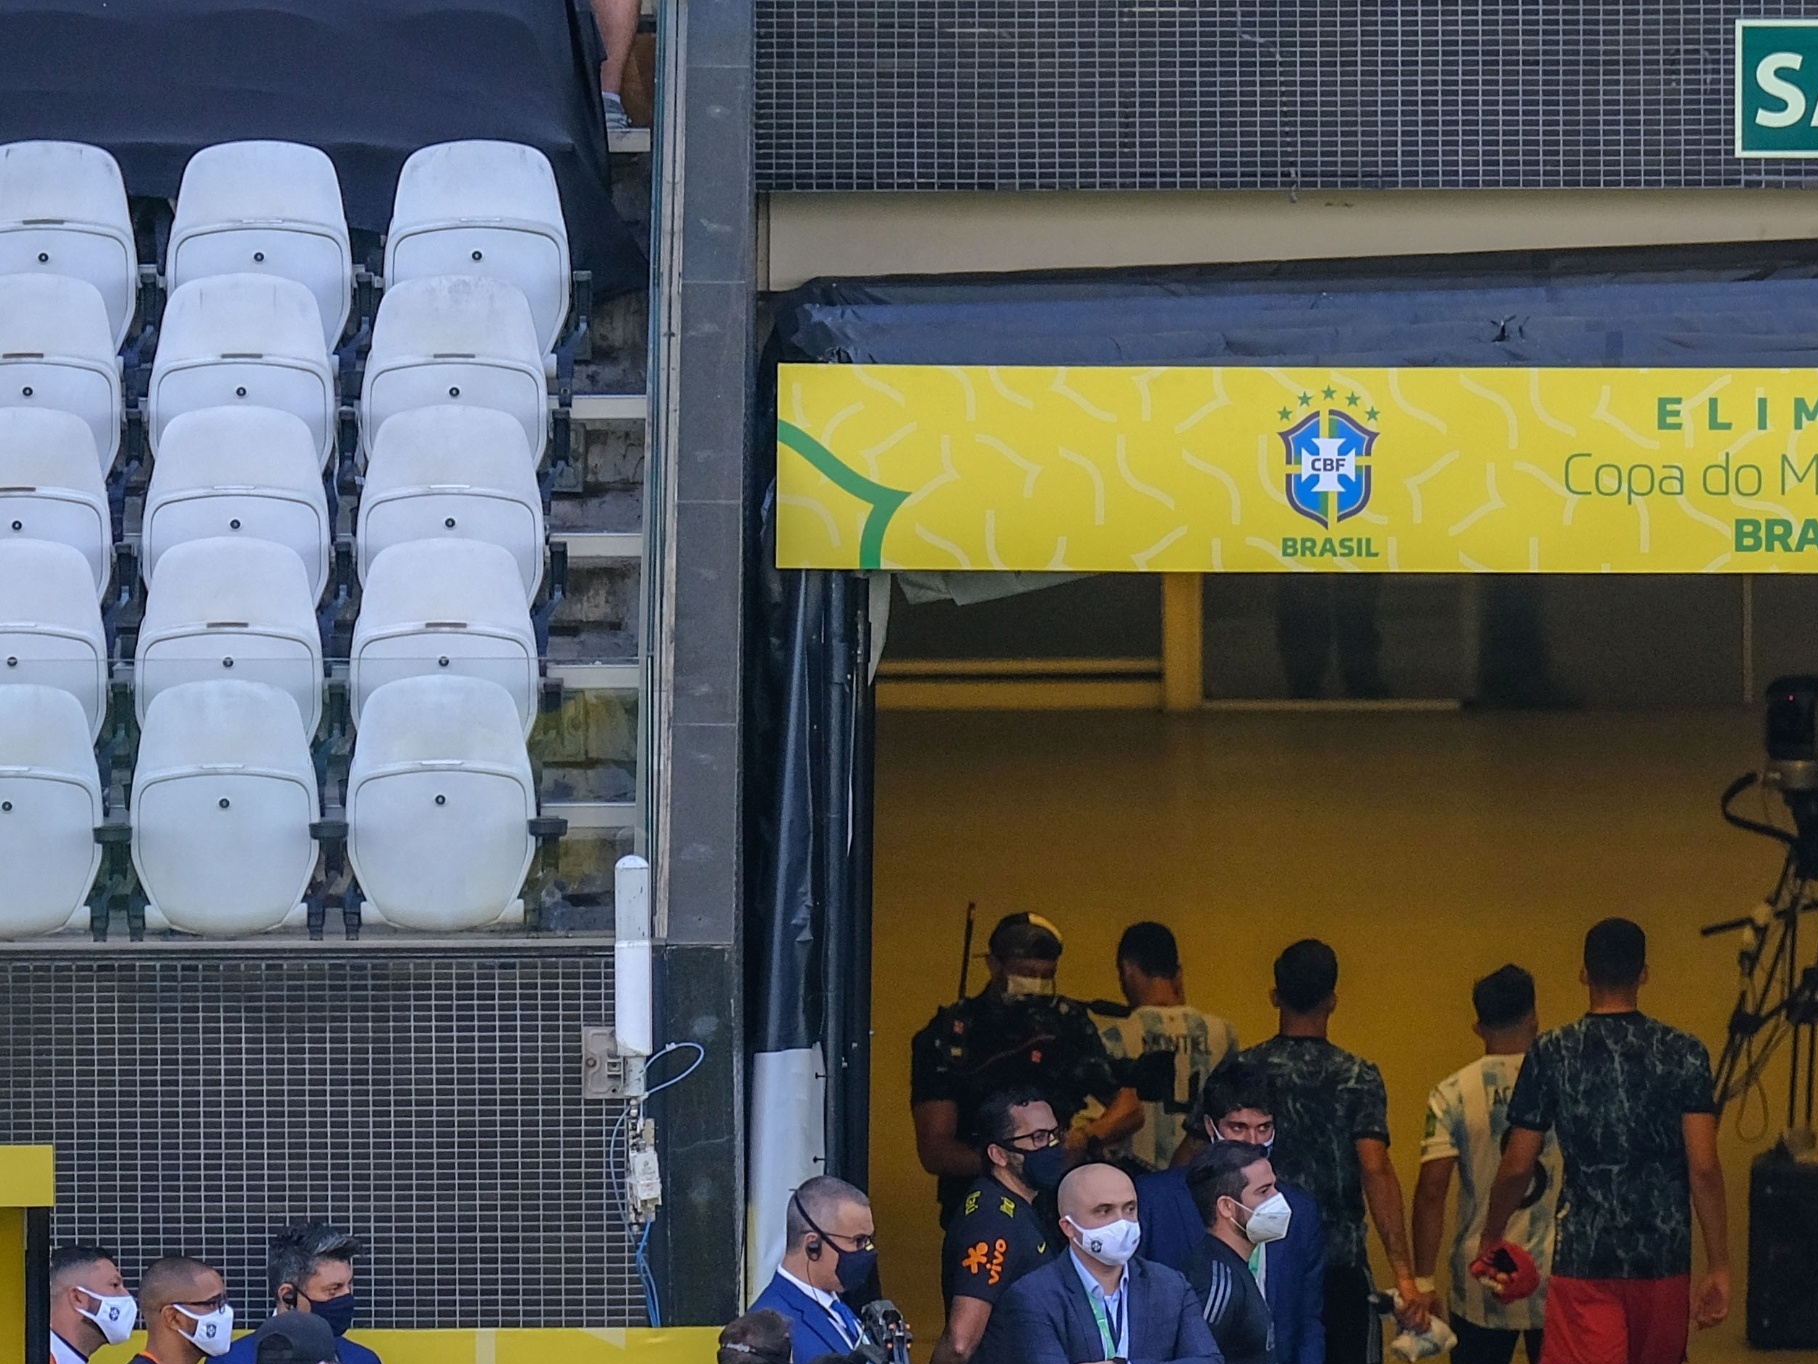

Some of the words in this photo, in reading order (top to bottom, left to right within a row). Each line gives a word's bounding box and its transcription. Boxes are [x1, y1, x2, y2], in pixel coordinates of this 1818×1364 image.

[1311, 457, 1346, 472] CBF
[1564, 453, 1684, 505] Copa
[1702, 452, 1762, 497] do
[1281, 537, 1380, 558] BRASIL
[986, 1238, 1008, 1286] vivo
